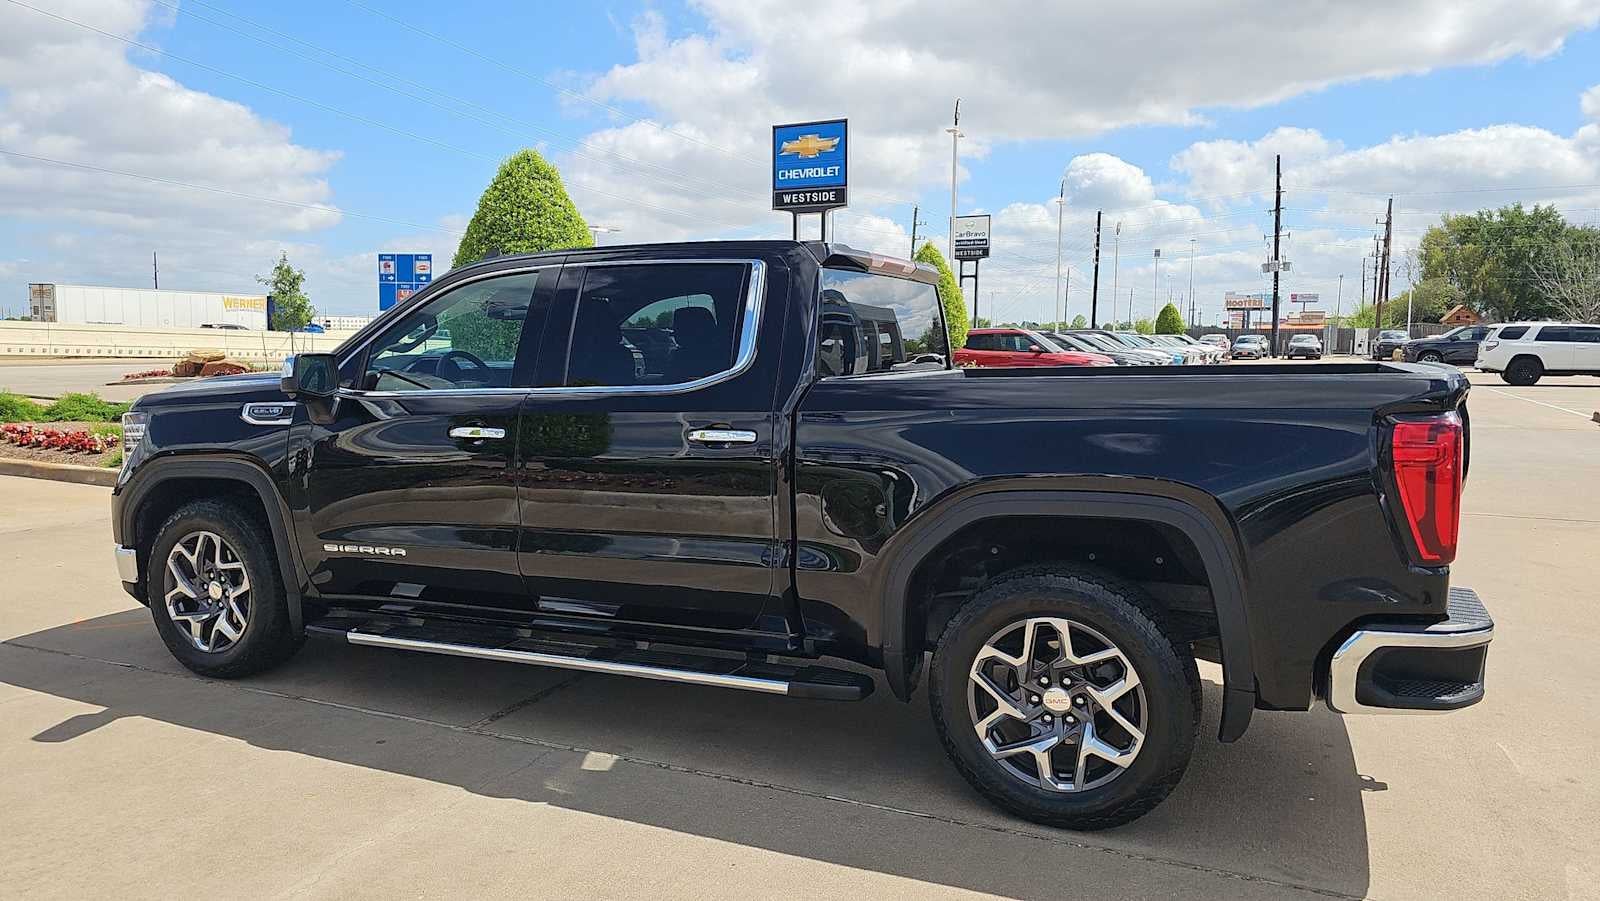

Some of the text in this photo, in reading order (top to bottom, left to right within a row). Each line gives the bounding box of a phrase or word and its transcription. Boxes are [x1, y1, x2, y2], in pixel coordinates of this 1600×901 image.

[779, 166, 840, 180] CHEVROLET
[783, 191, 836, 203] WESTSIDE
[223, 296, 266, 310] WERNER
[323, 543, 407, 557] SIERRA
